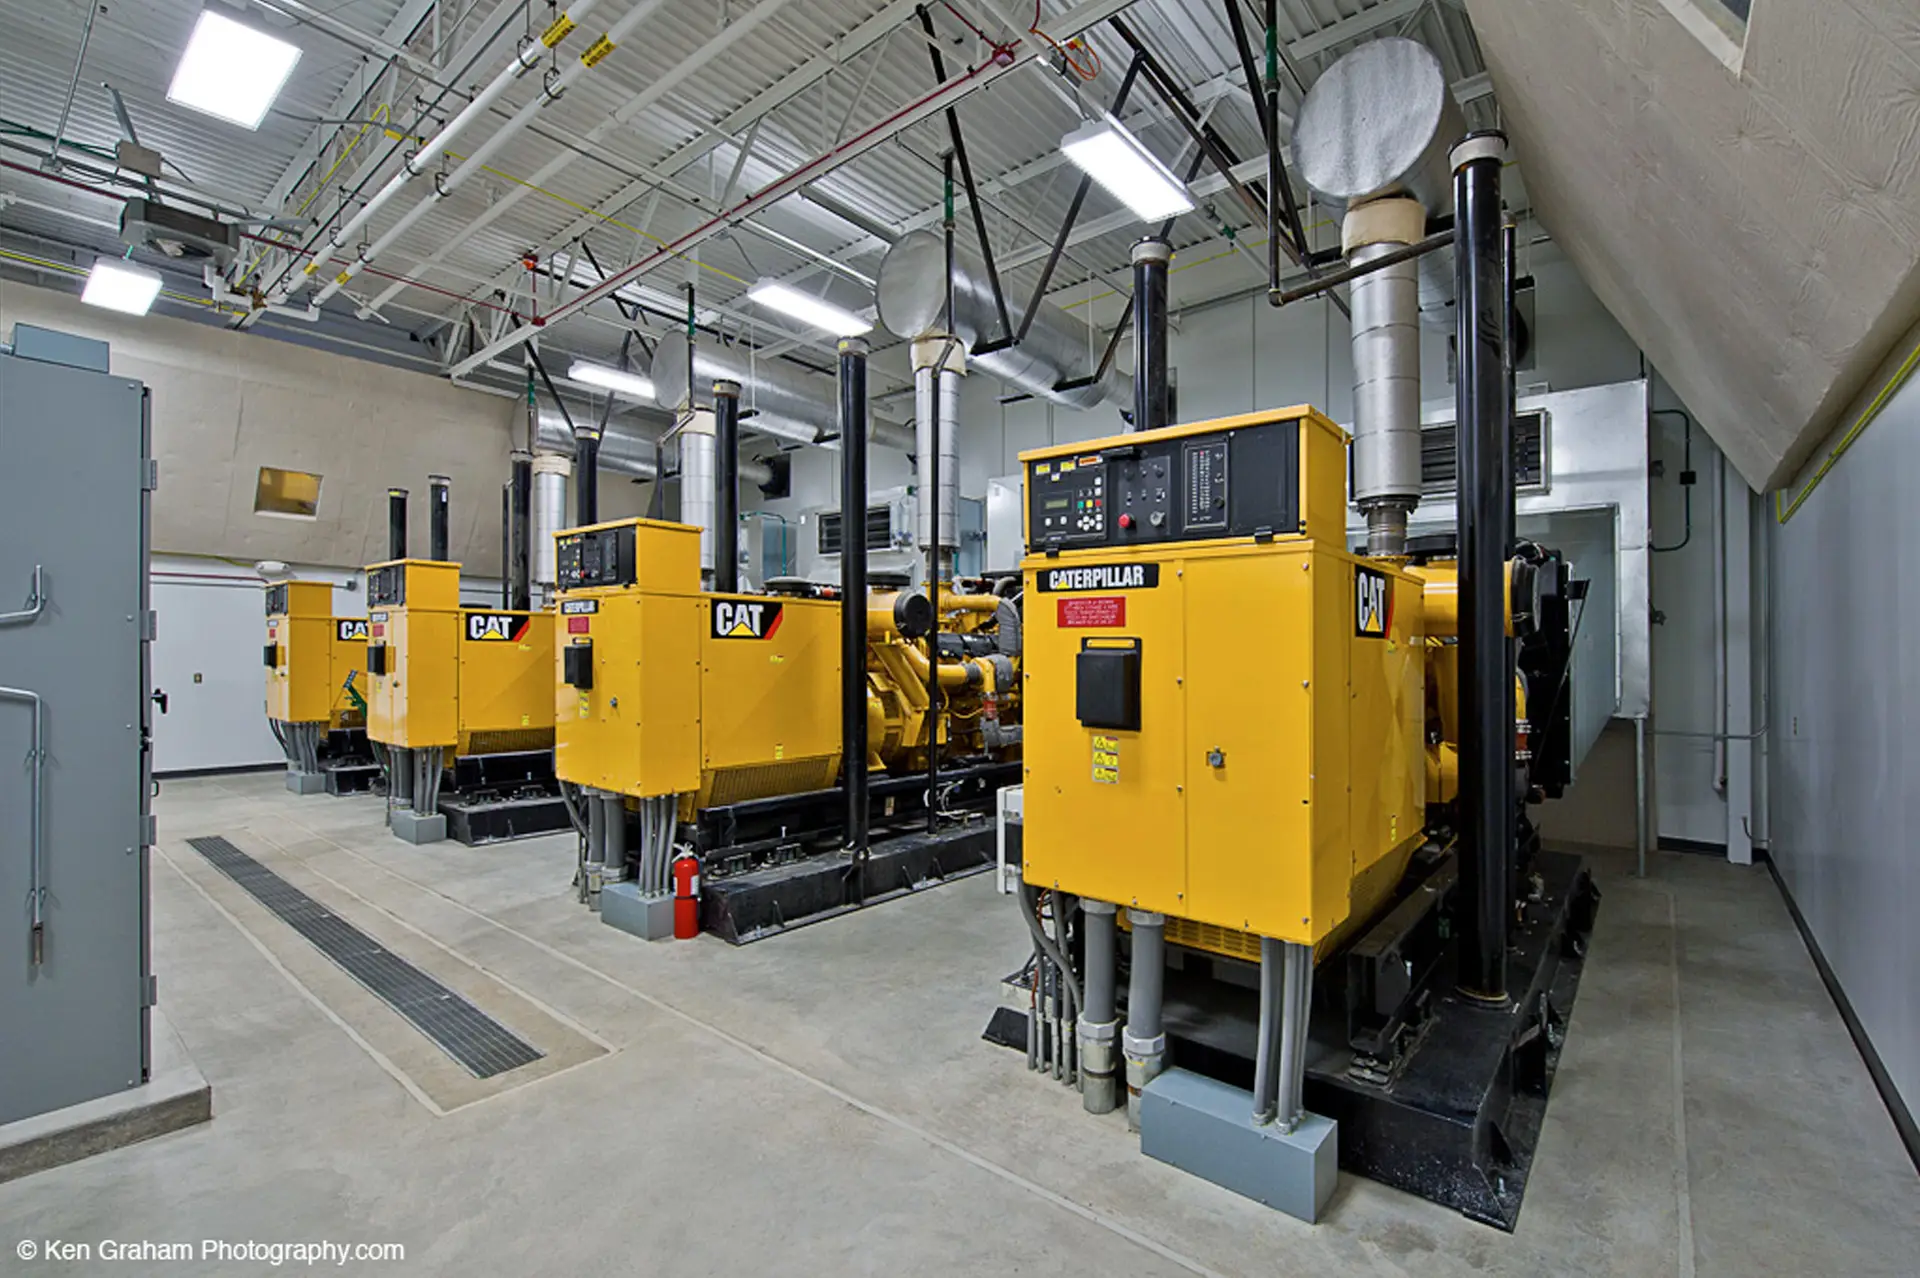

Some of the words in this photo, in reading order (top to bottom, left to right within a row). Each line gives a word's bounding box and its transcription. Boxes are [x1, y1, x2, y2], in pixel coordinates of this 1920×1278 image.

[1049, 565, 1144, 590] CATERPILLAR
[1358, 572, 1385, 633] CAT
[341, 621, 368, 640] CA
[470, 615, 513, 640] CAT
[716, 602, 764, 636] CAT
